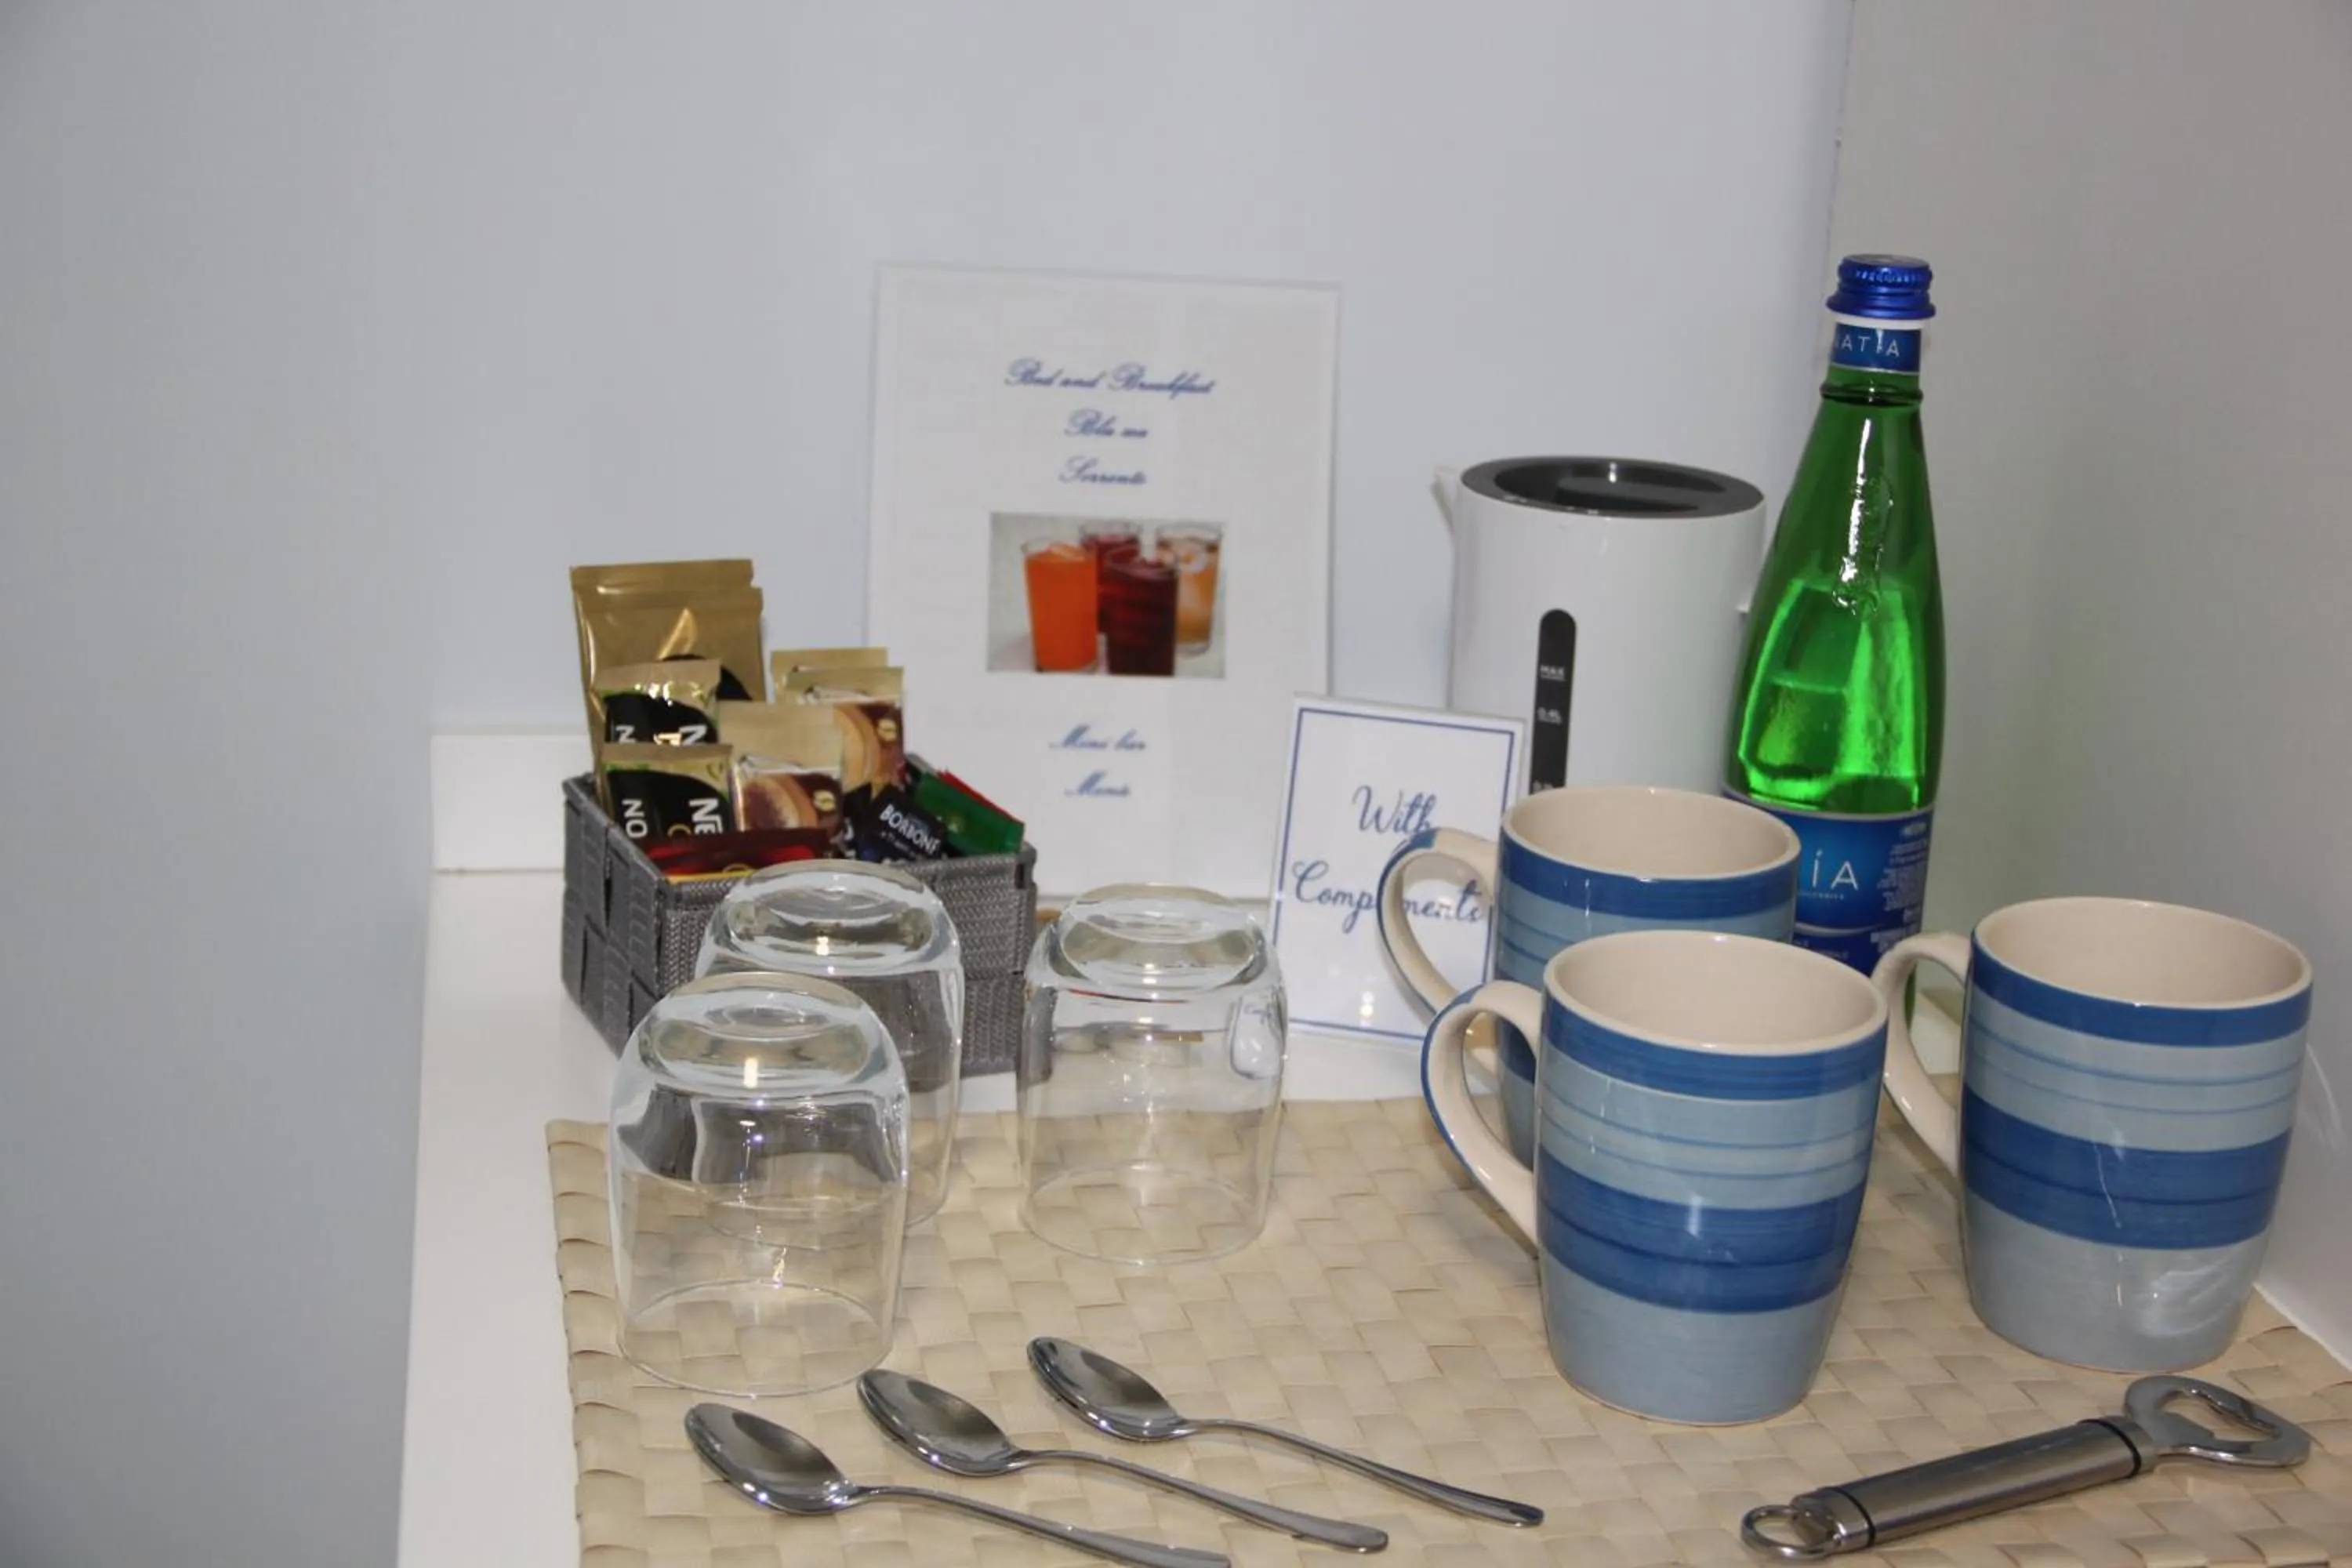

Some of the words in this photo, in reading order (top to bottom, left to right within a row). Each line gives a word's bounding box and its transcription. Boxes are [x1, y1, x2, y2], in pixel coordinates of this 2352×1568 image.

[1059, 369, 1107, 388] and
[1106, 361, 1217, 401] Breakfast
[1352, 785, 1437, 834] With
